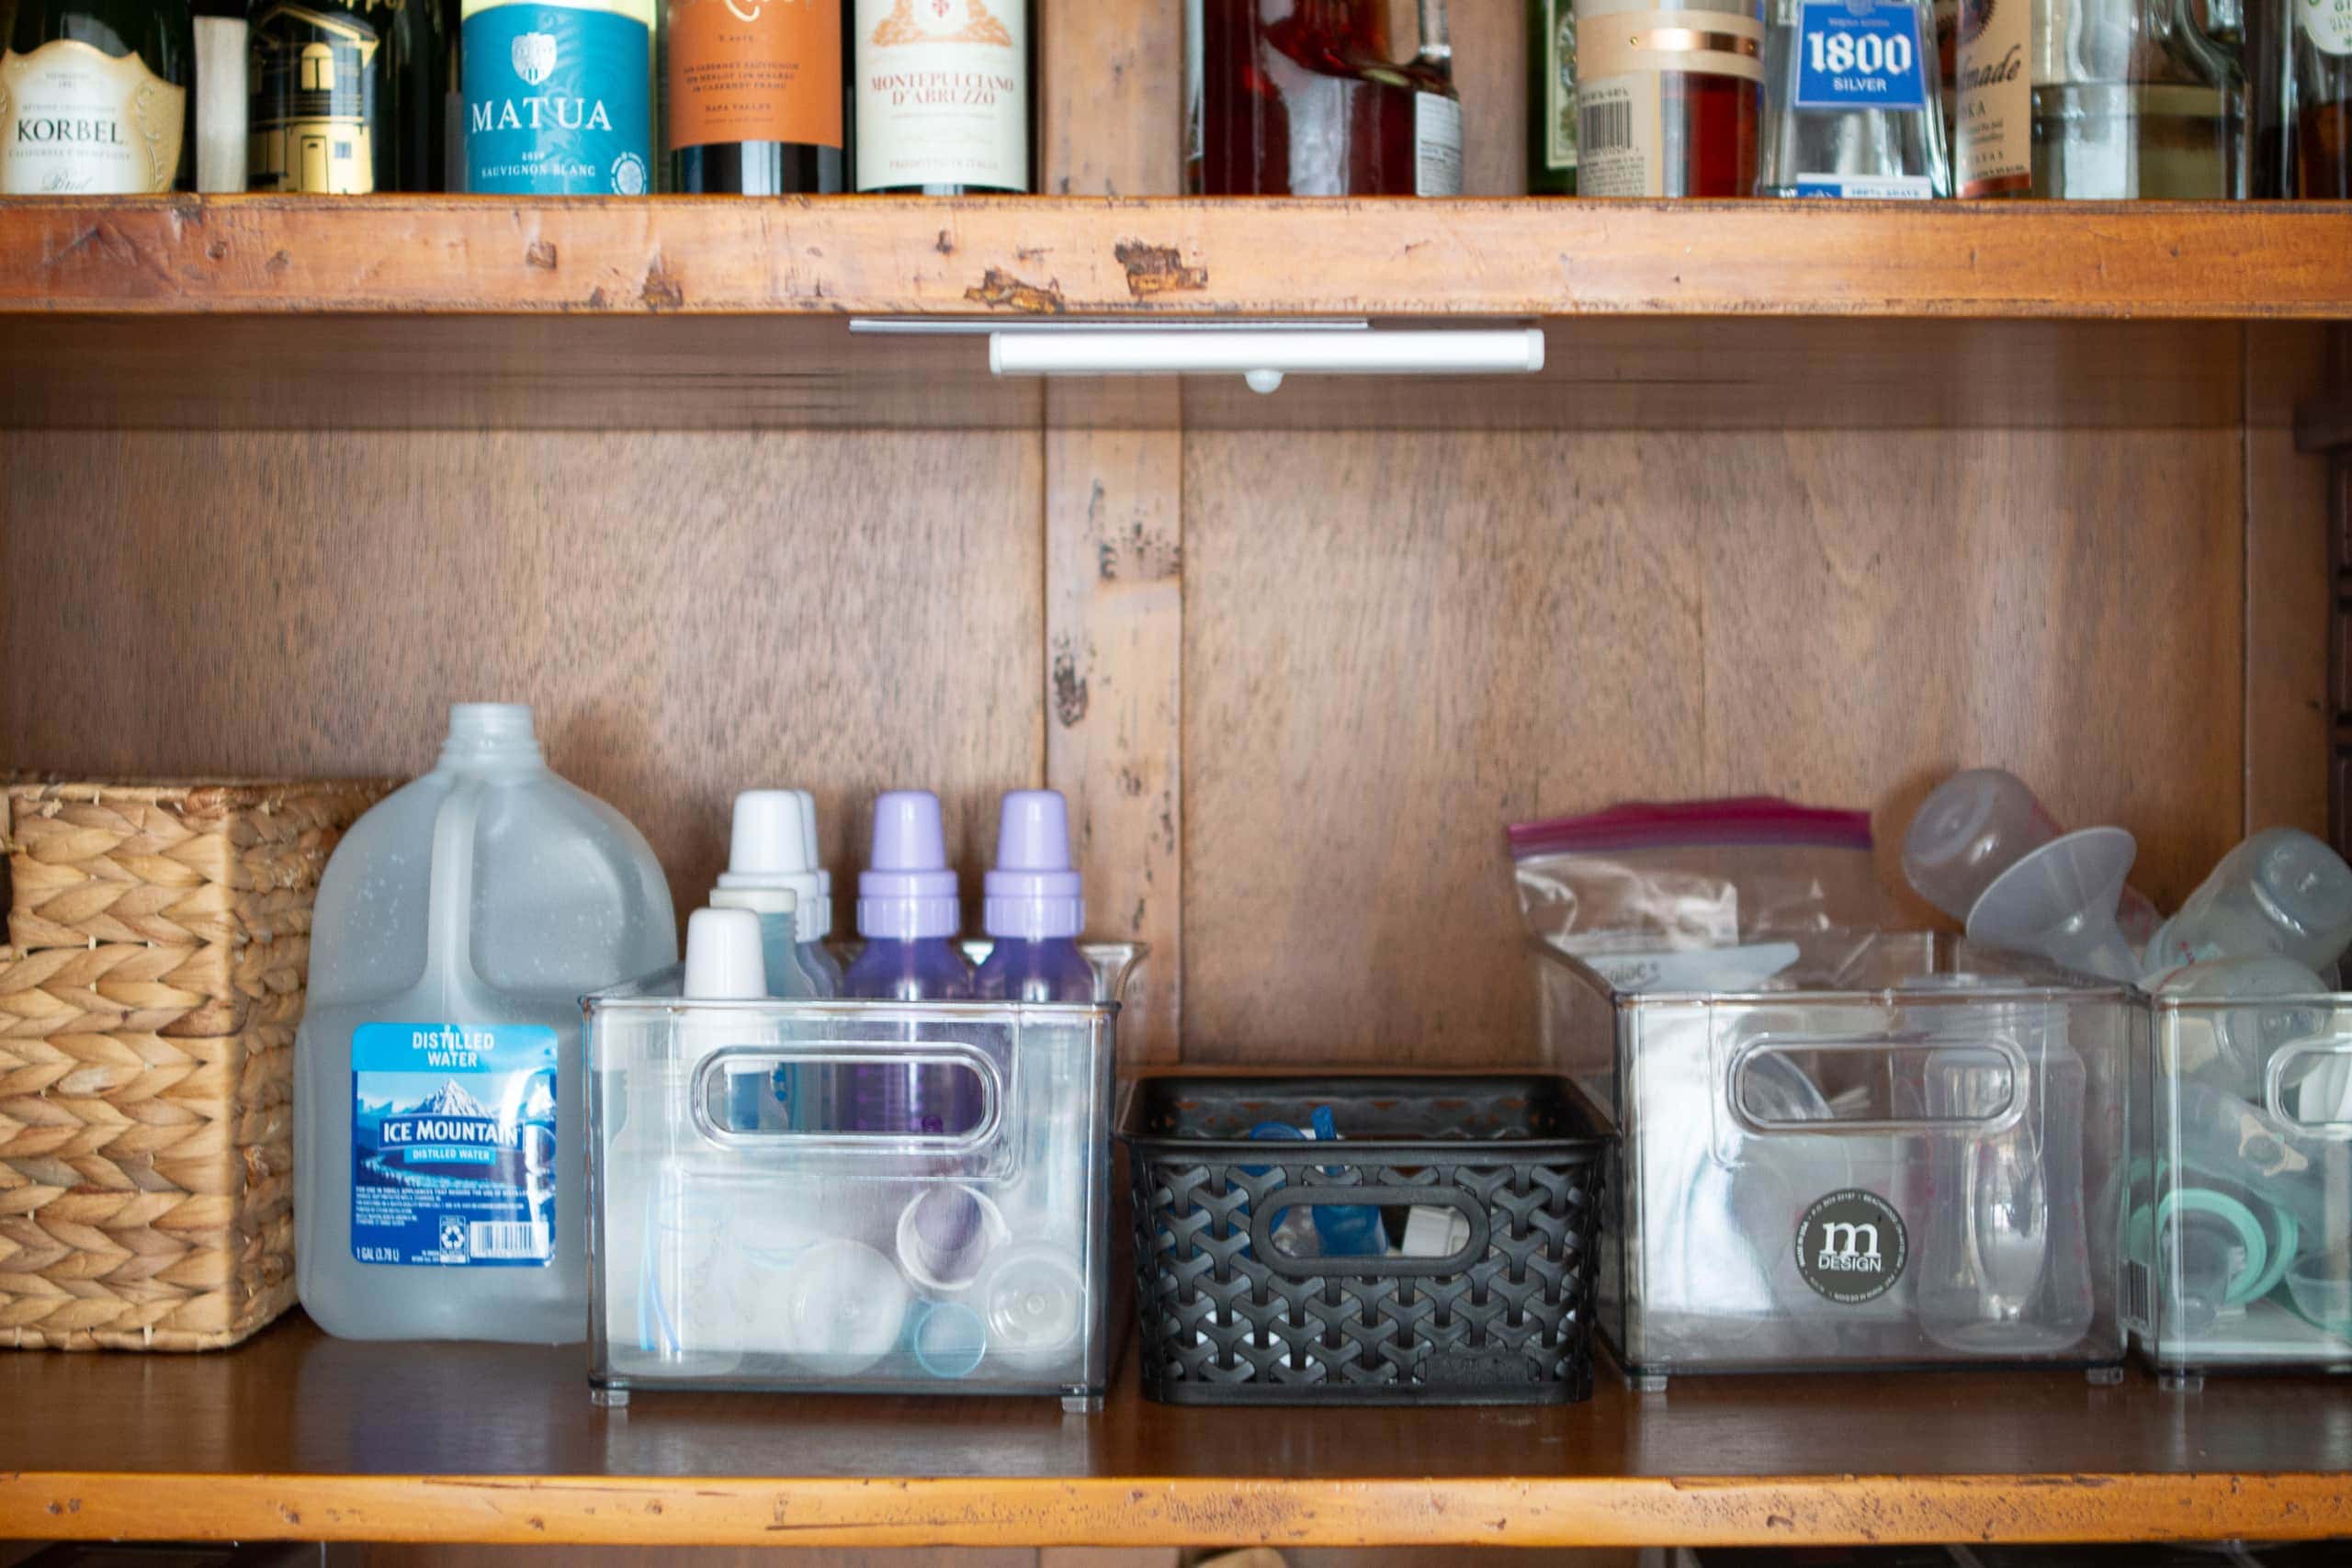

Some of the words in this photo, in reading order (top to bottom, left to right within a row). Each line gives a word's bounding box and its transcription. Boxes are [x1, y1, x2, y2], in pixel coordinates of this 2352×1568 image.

[1807, 31, 1912, 75] 1800
[872, 73, 1014, 93] MONTEPULCIANO
[1833, 77, 1887, 92] SILVER
[892, 88, 996, 106] D'ABRUZZO
[471, 96, 613, 133] MATUA
[17, 118, 120, 143] KORBEL
[481, 164, 548, 178] SAUVIGNON
[552, 164, 595, 177] BLANC
[413, 1031, 494, 1050] DISTILLED
[427, 1051, 477, 1067] WATER
[384, 1122, 412, 1143] ICE
[416, 1120, 518, 1146] MOUNTAIN
[413, 1149, 456, 1159] DISTILLED
[459, 1149, 490, 1160] WATER
[1819, 1222, 1882, 1258] m
[1818, 1254, 1882, 1272] DESIGN
